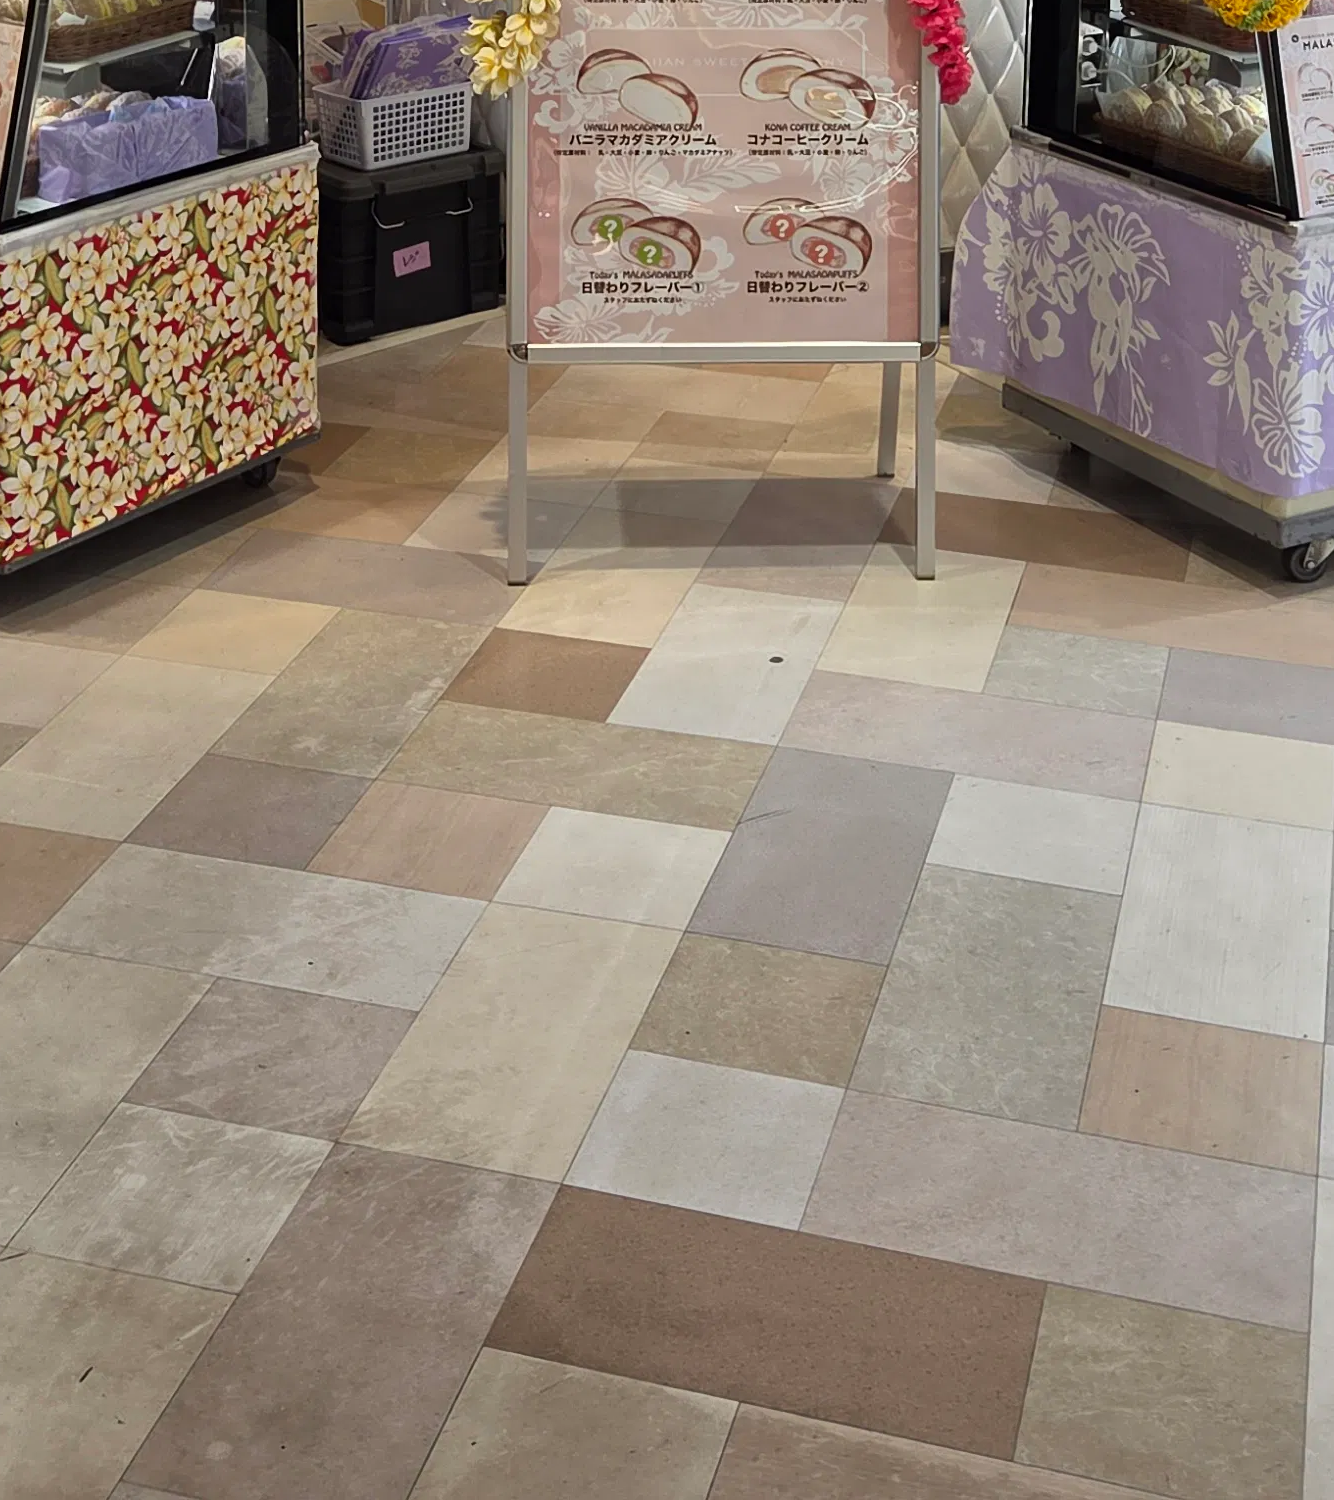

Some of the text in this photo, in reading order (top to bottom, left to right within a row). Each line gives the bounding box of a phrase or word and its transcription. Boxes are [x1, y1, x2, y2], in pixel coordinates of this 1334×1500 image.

[765, 123, 851, 131] KONA COFFEE CREAM
[569, 134, 717, 146] バニラマカダミアクリーム
[747, 133, 869, 145] コナコーヒークリーム
